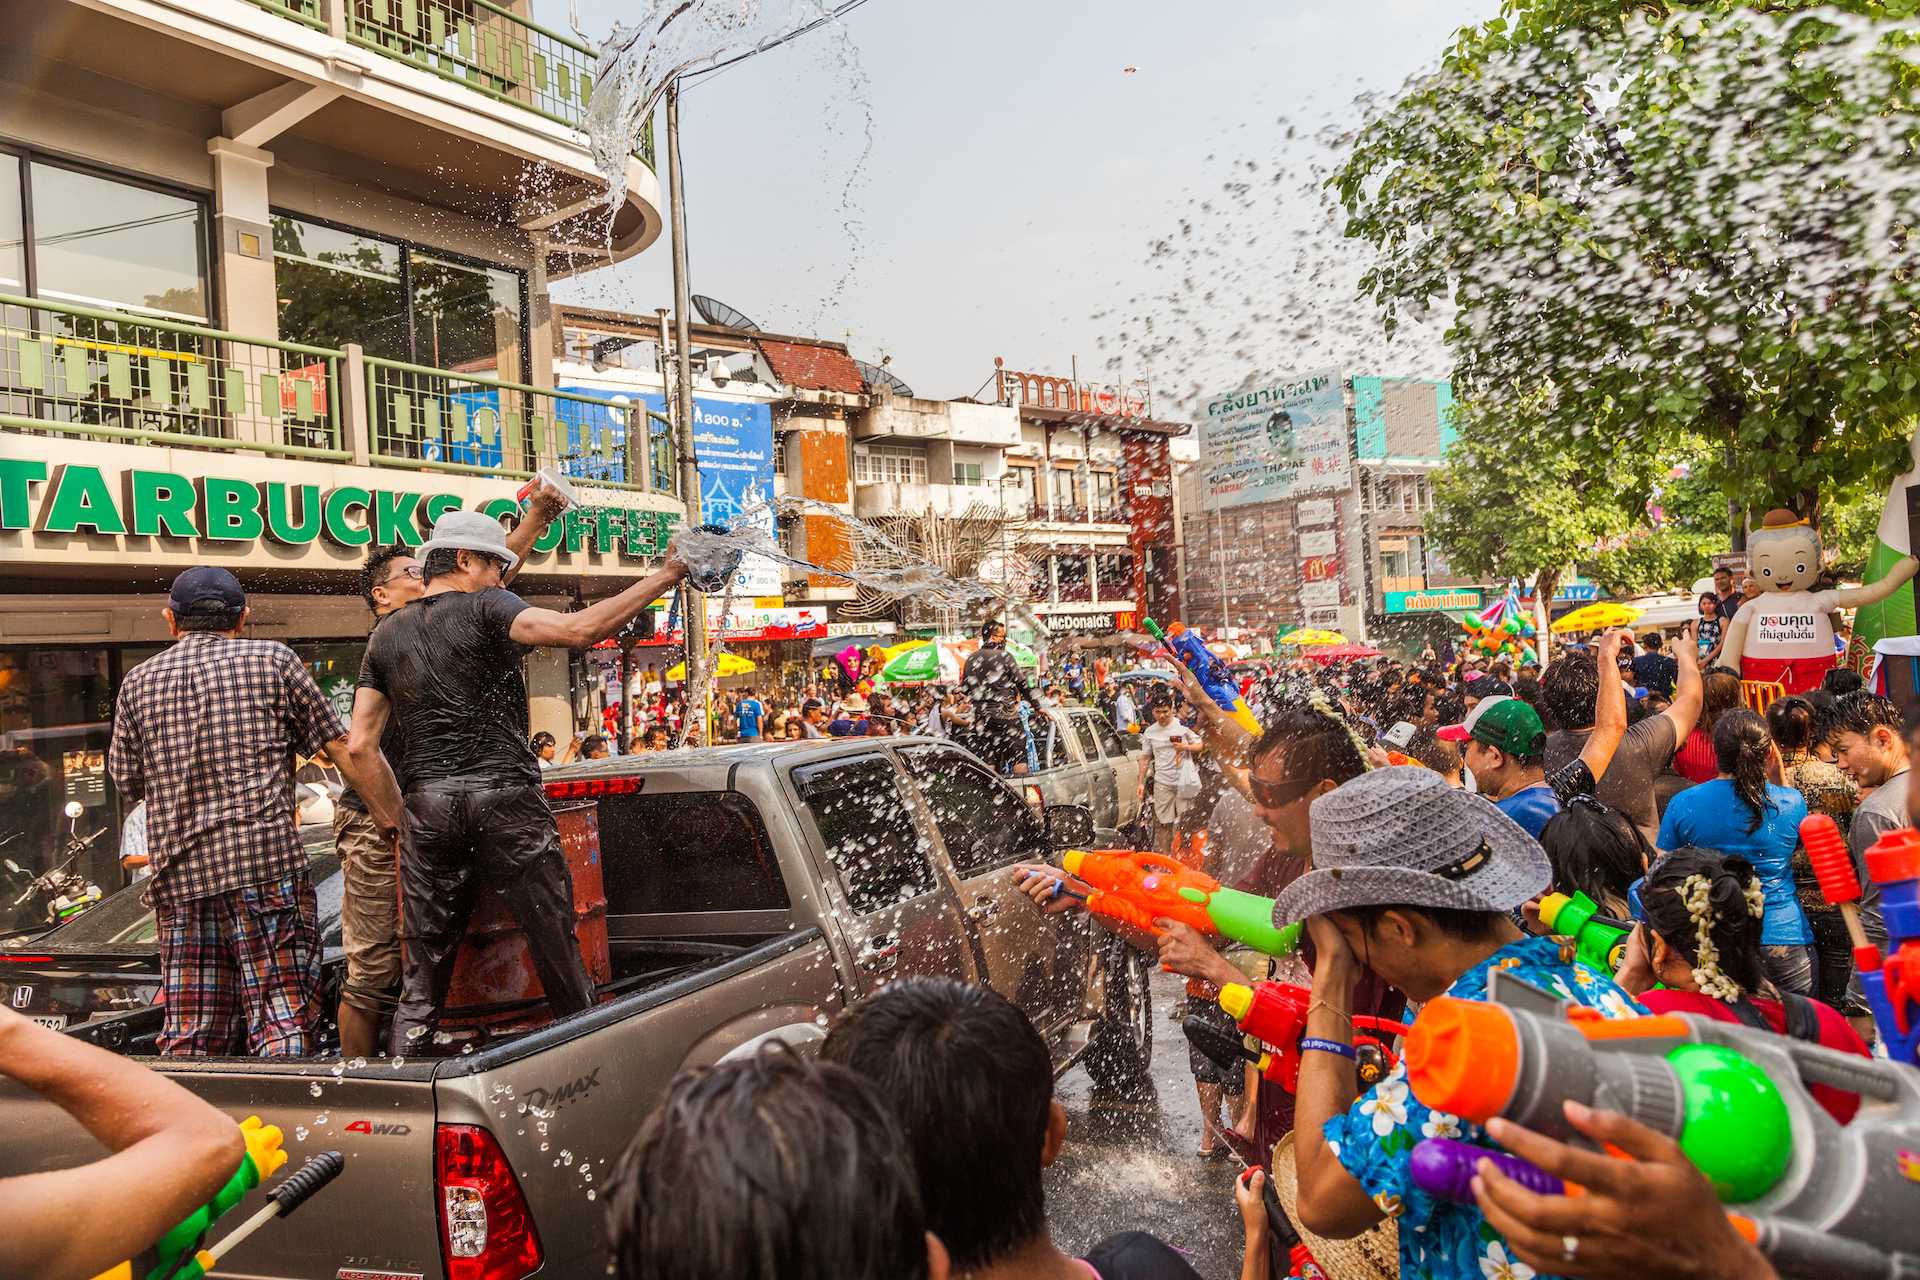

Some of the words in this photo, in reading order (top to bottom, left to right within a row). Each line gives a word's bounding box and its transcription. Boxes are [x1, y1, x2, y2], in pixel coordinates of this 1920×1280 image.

[760, 600, 777, 608] OPEN
[1405, 591, 1480, 611] คลังยาท่าแพ
[1760, 614, 1814, 628] ขบคุณ
[1759, 626, 1815, 642] ที่ไม่สูบไม่ดื่ม
[1311, 1040, 1342, 1053] Mahidol
[344, 1120, 412, 1136] 4WD
